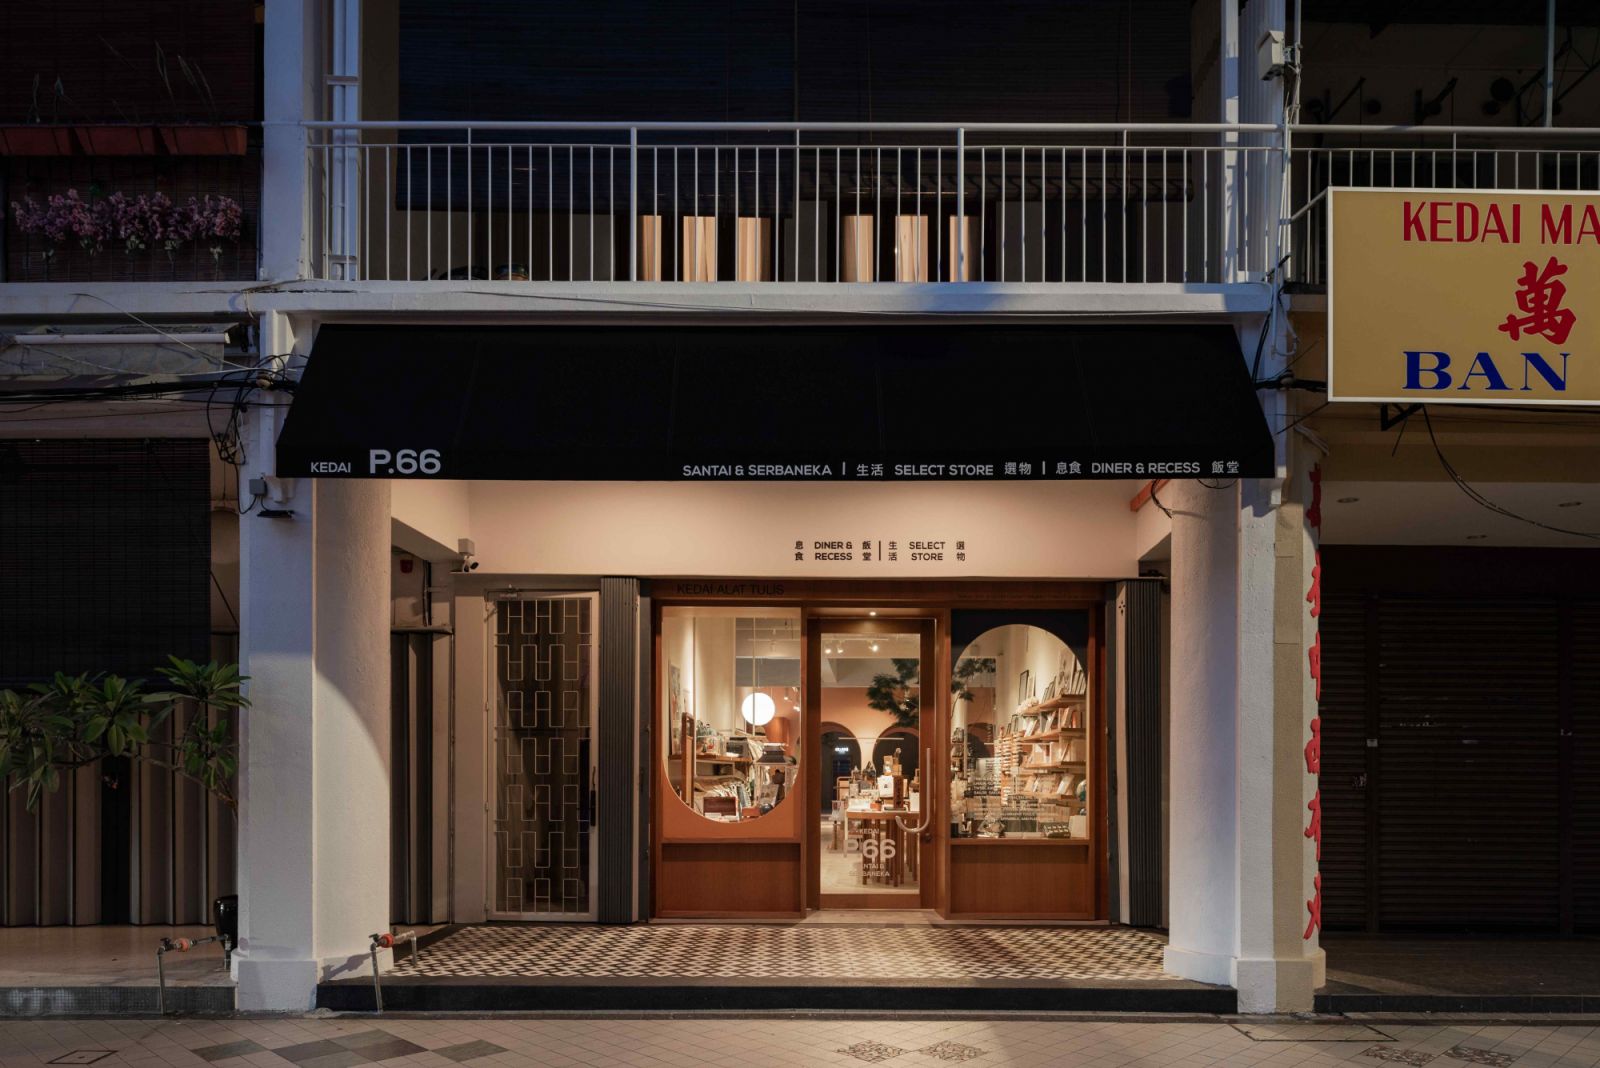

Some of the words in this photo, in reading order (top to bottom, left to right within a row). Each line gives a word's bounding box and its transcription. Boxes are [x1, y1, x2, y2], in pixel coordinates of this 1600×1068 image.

[1403, 201, 1521, 244] KEDAI
[1498, 256, 1577, 345] 萬
[1402, 351, 1571, 391] BAN
[310, 462, 351, 473] KEDAI
[369, 449, 441, 474] P.66
[682, 465, 732, 476] SANTAI
[734, 465, 745, 476] &
[748, 465, 832, 476] SERBANEKA
[856, 463, 884, 476] 生活
[894, 465, 945, 476] SELECT
[949, 465, 993, 476] STORE
[1004, 461, 1031, 475] 選物
[1056, 461, 1082, 475] 息食
[1091, 463, 1132, 474] DINER
[1135, 463, 1145, 474] &
[1149, 462, 1200, 474] RECESS
[1212, 460, 1239, 474] 飯堂
[814, 541, 843, 550] DINER
[909, 541, 946, 550] SELECT
[814, 553, 853, 561] RECESS
[911, 552, 944, 561] STORE
[677, 584, 713, 595] KEDAI
[716, 584, 744, 595] ALAT
[751, 584, 785, 595] TULIS
